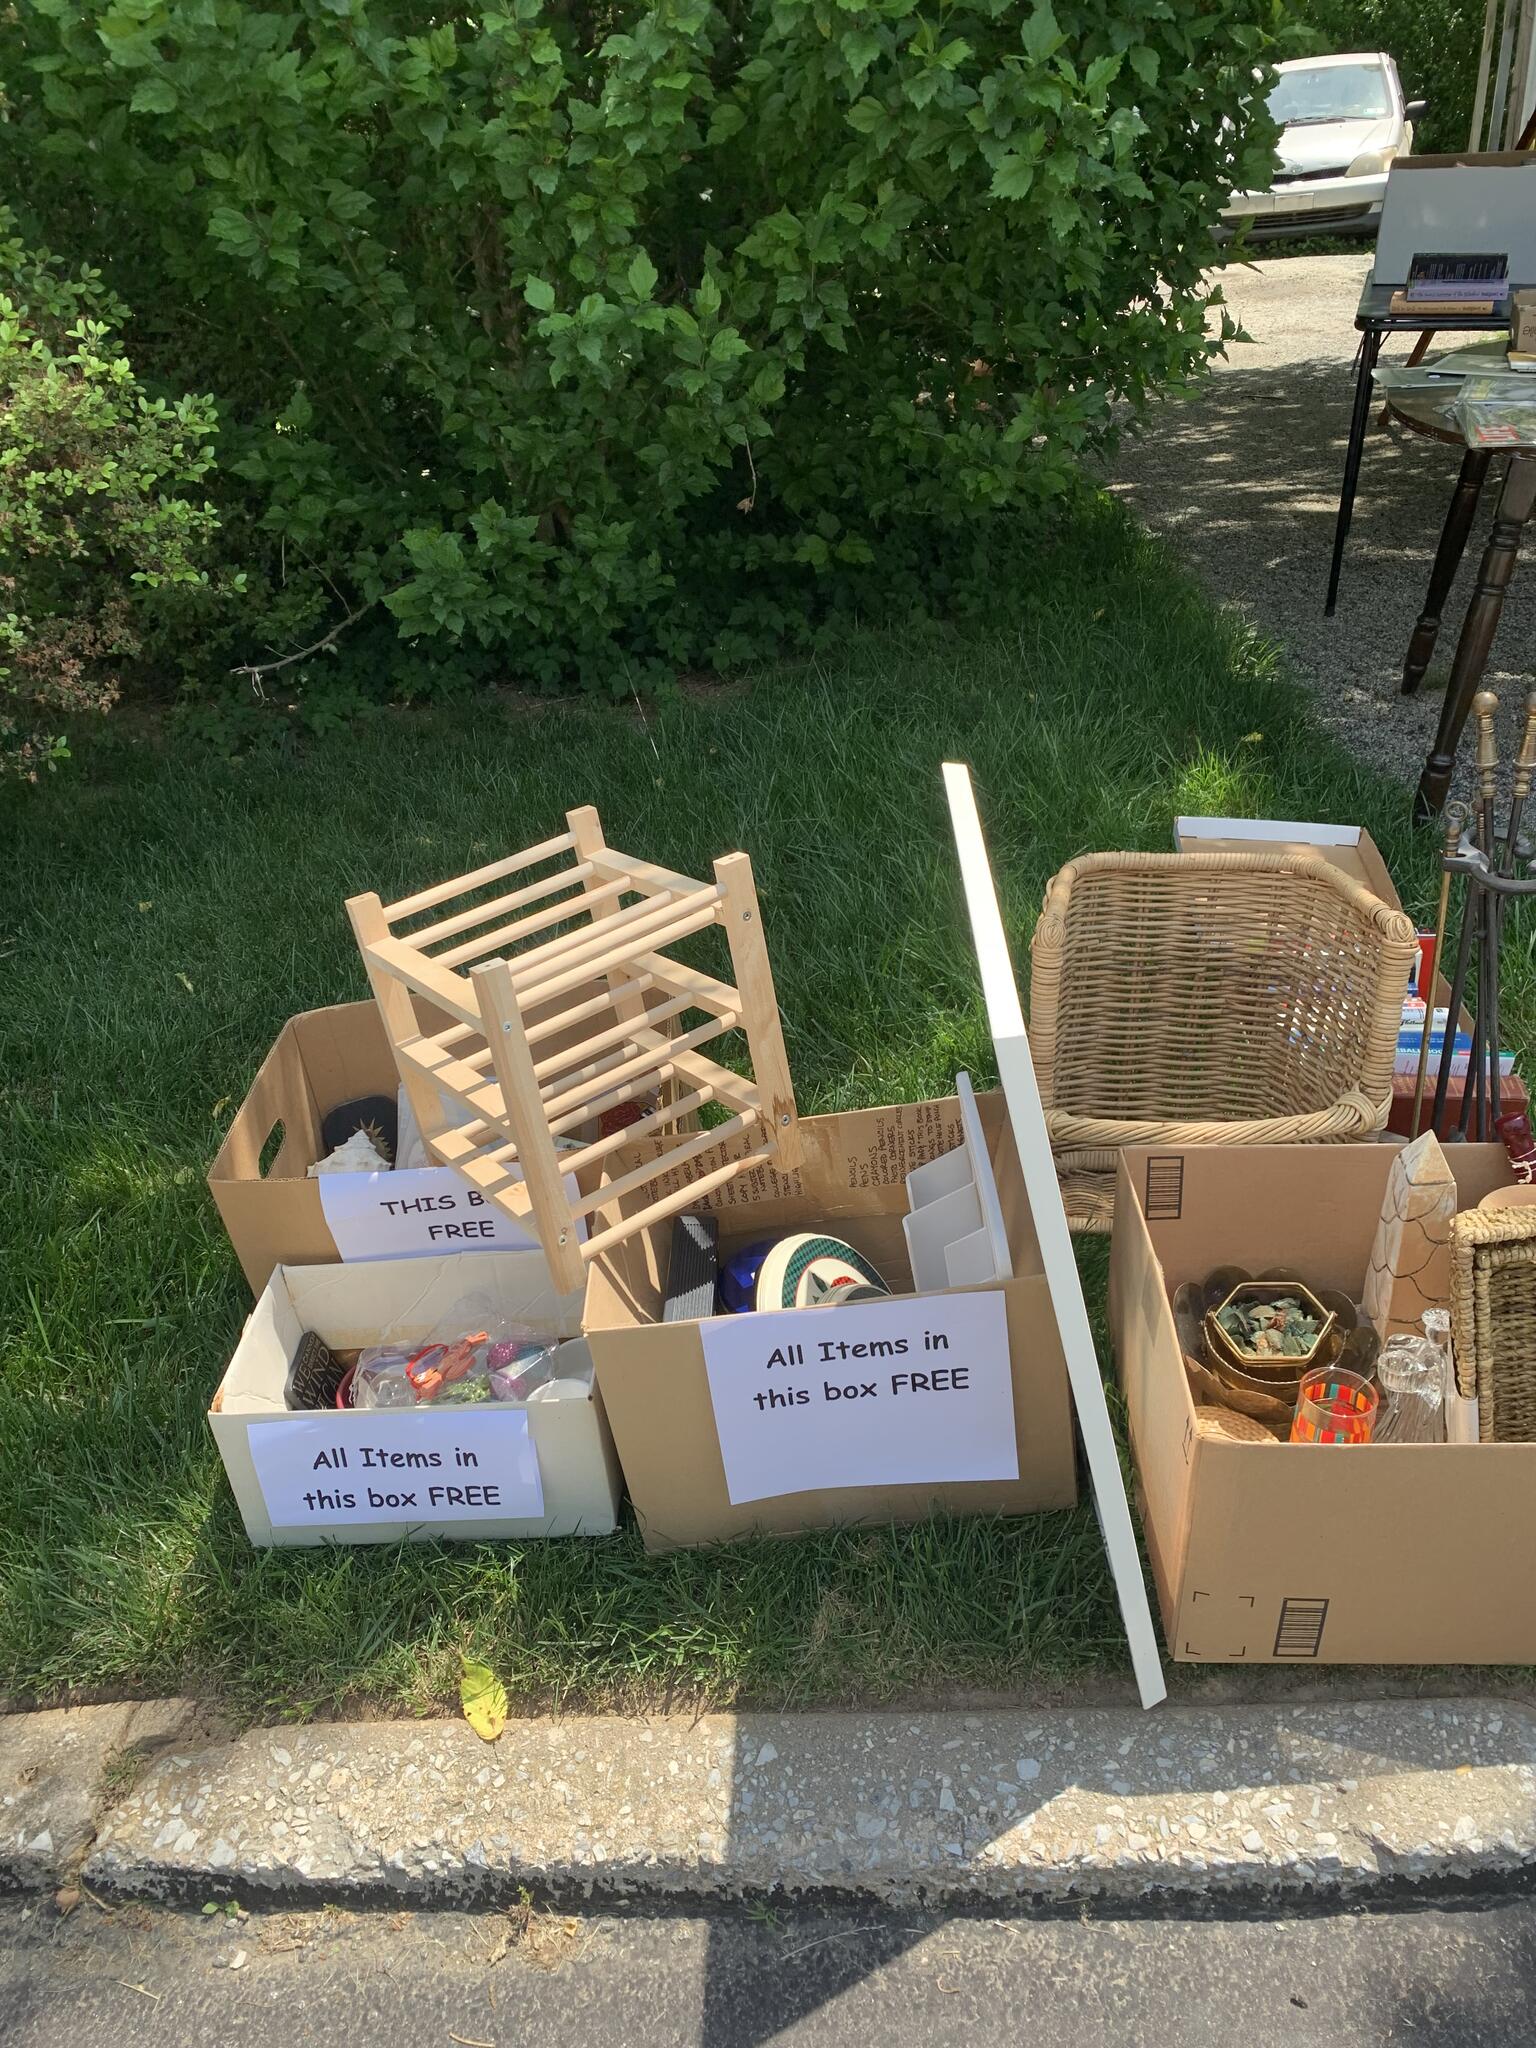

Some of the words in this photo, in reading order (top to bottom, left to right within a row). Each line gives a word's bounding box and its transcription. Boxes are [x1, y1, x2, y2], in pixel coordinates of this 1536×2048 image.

[848, 1156, 858, 1187] PENCILS
[859, 1163, 869, 1187] PENS
[869, 1145, 880, 1186] CRAYONS
[380, 1195, 456, 1215] THIS
[428, 1220, 496, 1240] FREE
[766, 1344, 804, 1369] All
[817, 1338, 909, 1362] Items
[924, 1330, 949, 1350] in
[753, 1386, 810, 1411] this
[823, 1381, 878, 1401] box
[891, 1367, 970, 1395] FREE
[313, 1447, 348, 1470] All
[359, 1447, 442, 1468] Items
[455, 1447, 478, 1467] in
[303, 1489, 356, 1511] this
[367, 1487, 417, 1508] box
[428, 1485, 501, 1507] FREE
